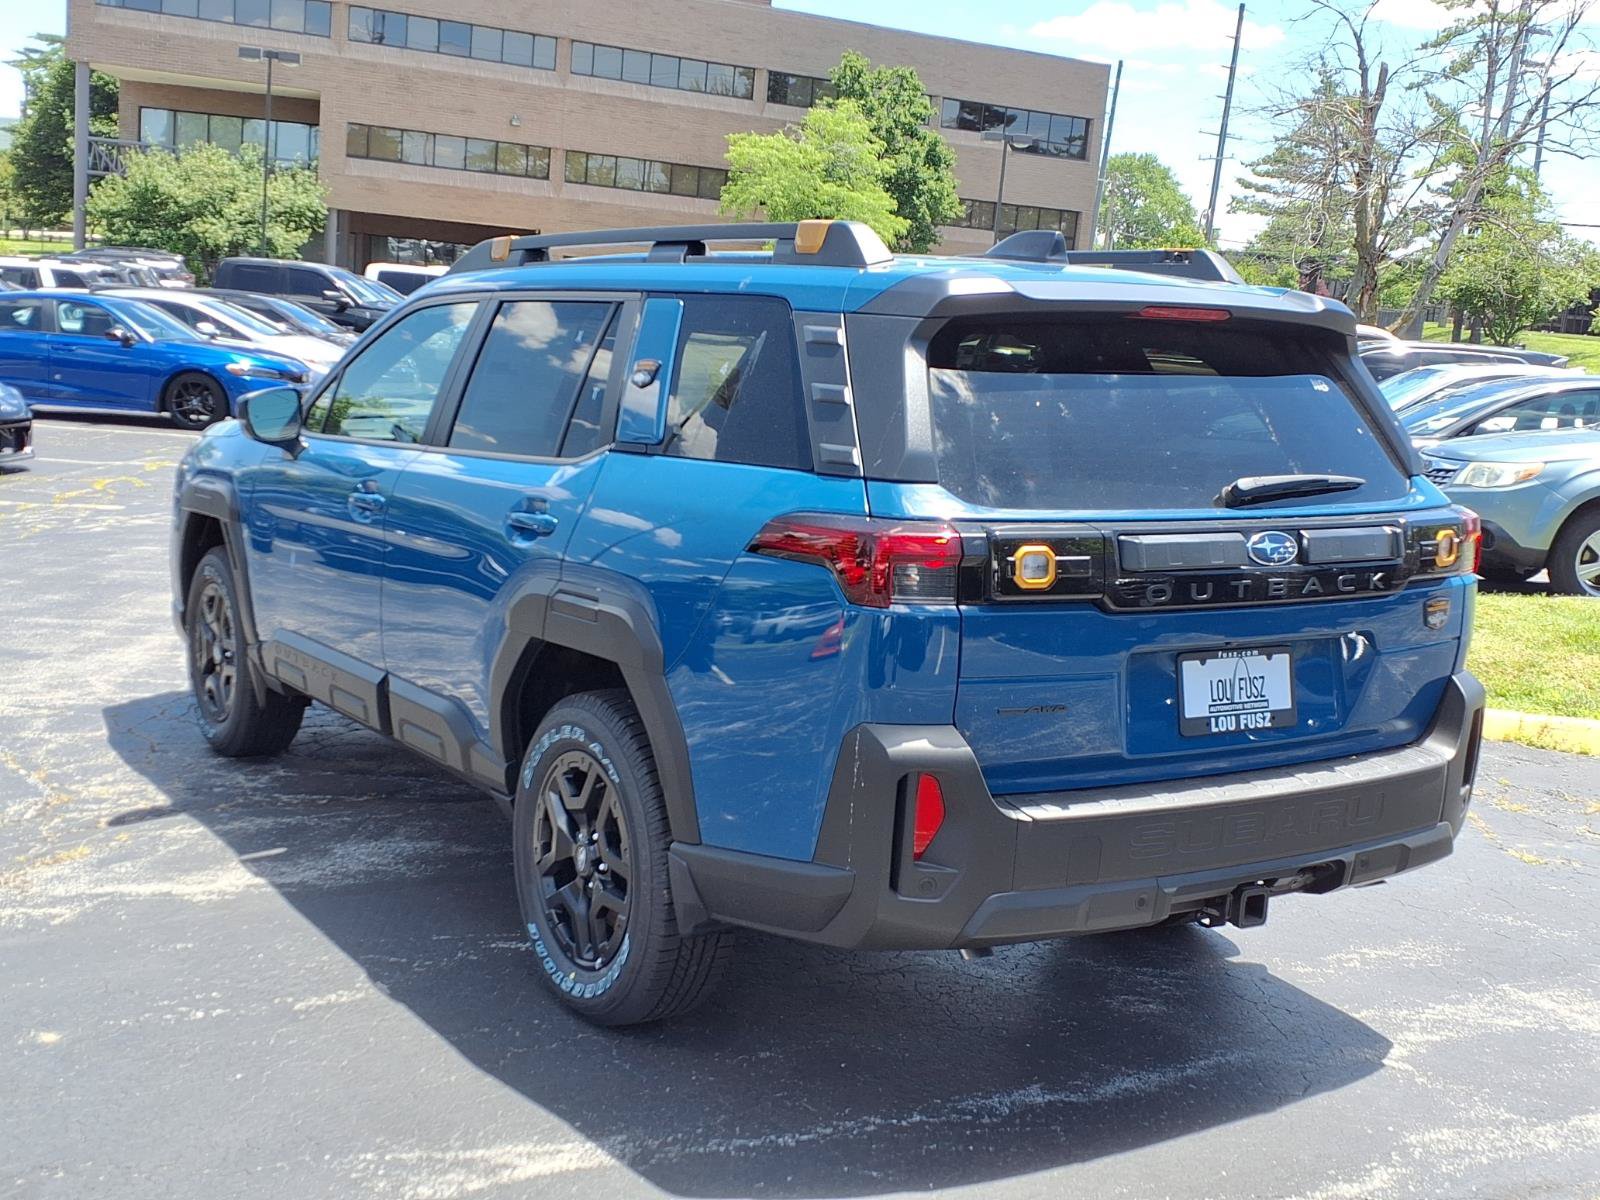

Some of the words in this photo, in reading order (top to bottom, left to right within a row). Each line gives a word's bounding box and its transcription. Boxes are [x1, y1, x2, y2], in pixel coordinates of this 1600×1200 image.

[1145, 571, 1386, 601] OUTBACK
[1210, 678, 1232, 703] LOU
[1239, 675, 1266, 701] FUSZ
[1211, 716, 1236, 732] LOU
[1240, 712, 1271, 729] FUSZ
[1129, 792, 1386, 860] SUBARU
